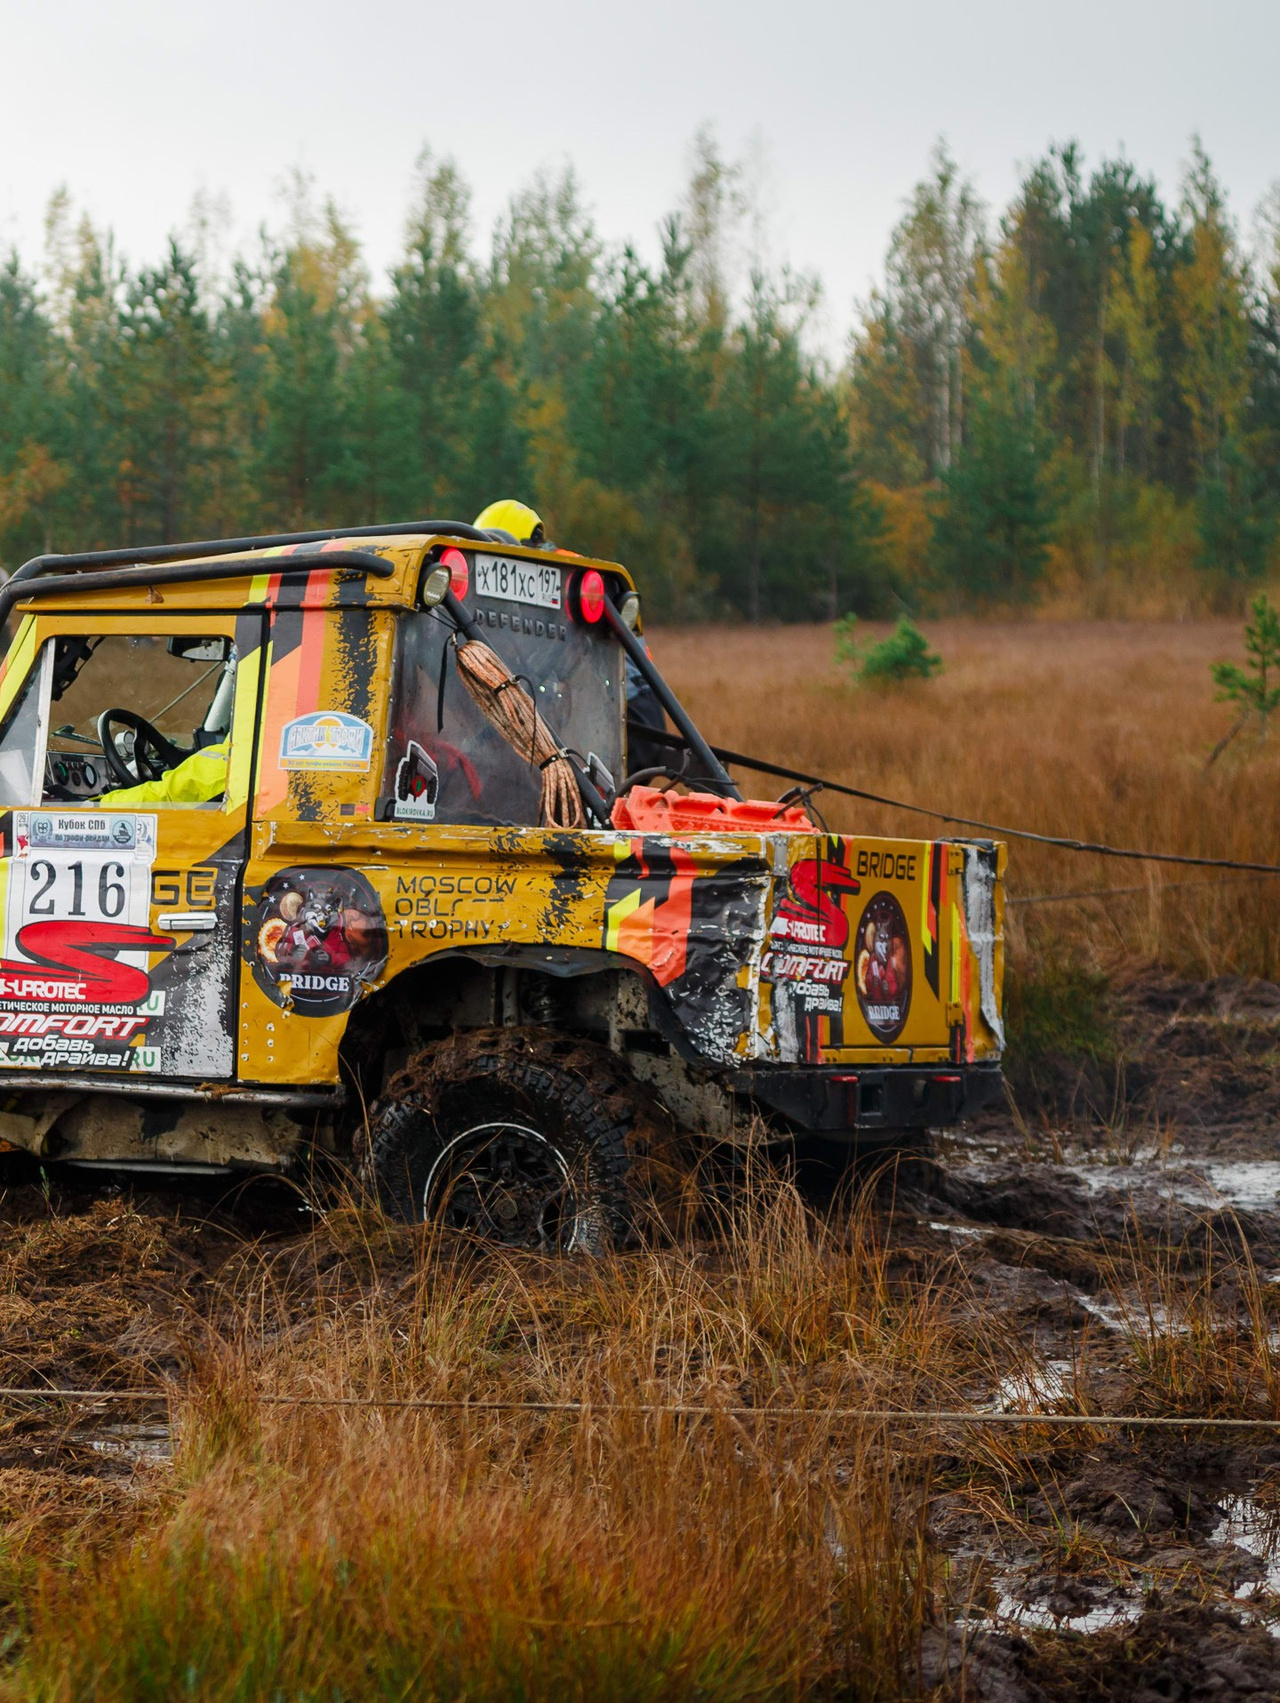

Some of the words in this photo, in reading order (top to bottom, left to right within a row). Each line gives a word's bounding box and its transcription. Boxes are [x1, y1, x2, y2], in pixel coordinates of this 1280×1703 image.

[474, 608, 568, 641] DEFENDER
[58, 819, 86, 830] Кубок
[88, 820, 106, 830] СПб
[856, 850, 917, 881] BRIDGE
[28, 860, 126, 917] 216
[395, 875, 518, 895] MOSCOW
[394, 919, 492, 940] TROPHY
[4, 980, 87, 1000] SUPROTEC
[51, 1002, 101, 1014] МОТОРНОЕ
[101, 1004, 134, 1016] МАСЛО
[867, 1004, 901, 1021] BRIDGE
[12, 1034, 95, 1053] добавь
